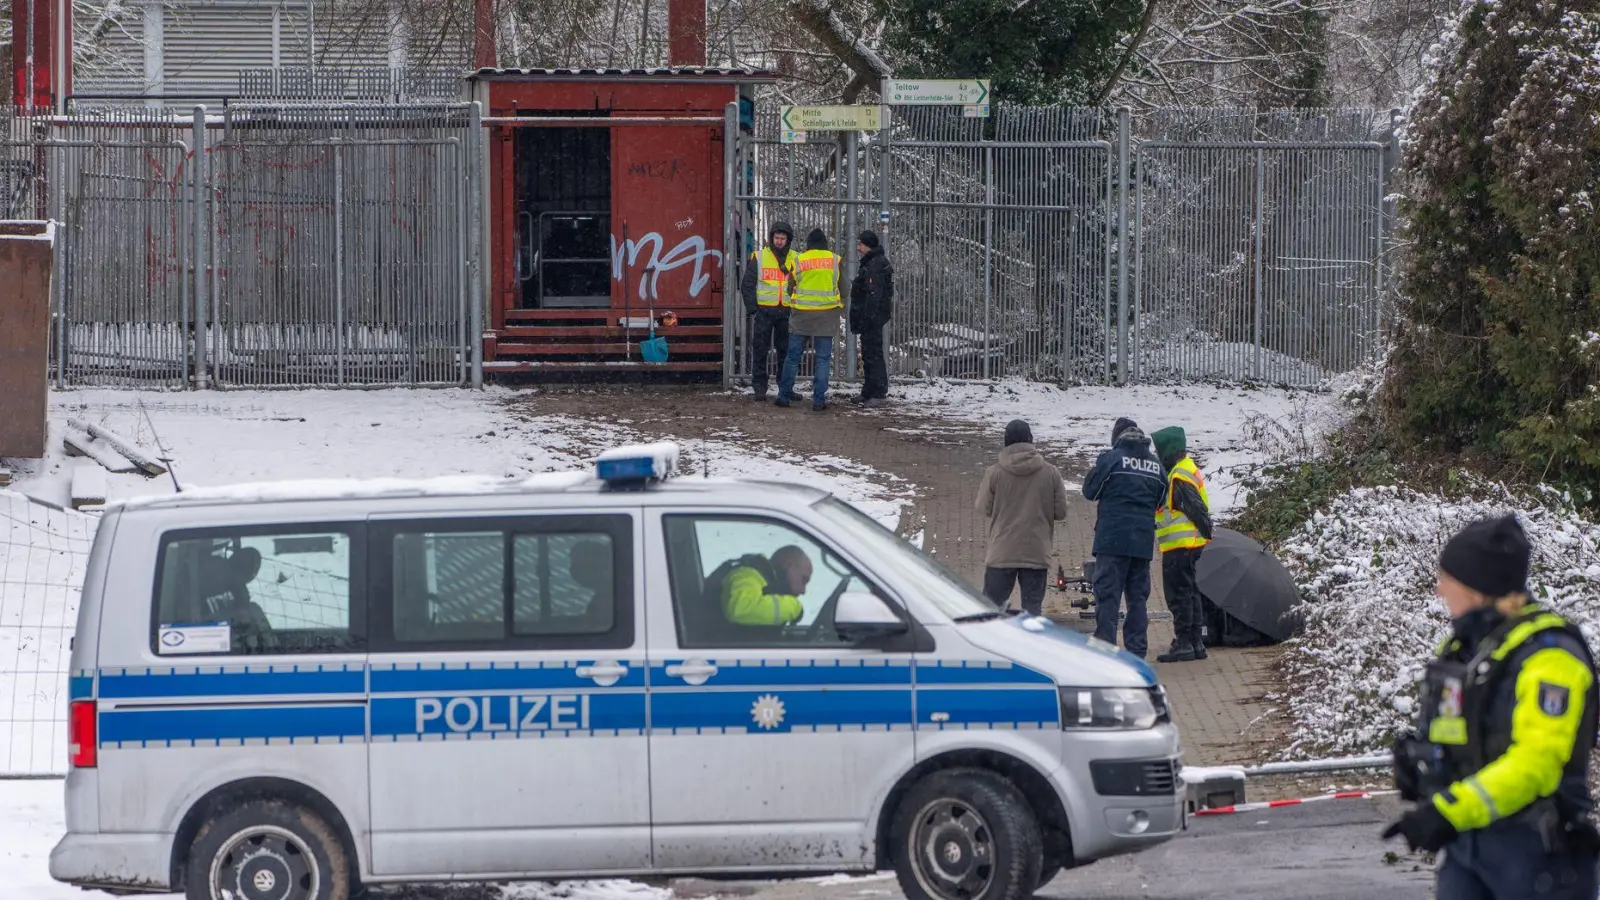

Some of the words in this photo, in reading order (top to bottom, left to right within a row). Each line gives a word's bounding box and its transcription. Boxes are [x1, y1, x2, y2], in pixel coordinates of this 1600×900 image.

[802, 109, 822, 117] Mitte
[866, 109, 872, 117] 13
[799, 258, 833, 272] POLIZEI
[1122, 456, 1160, 475] POLIZEI
[415, 694, 590, 733] POLIZEI
